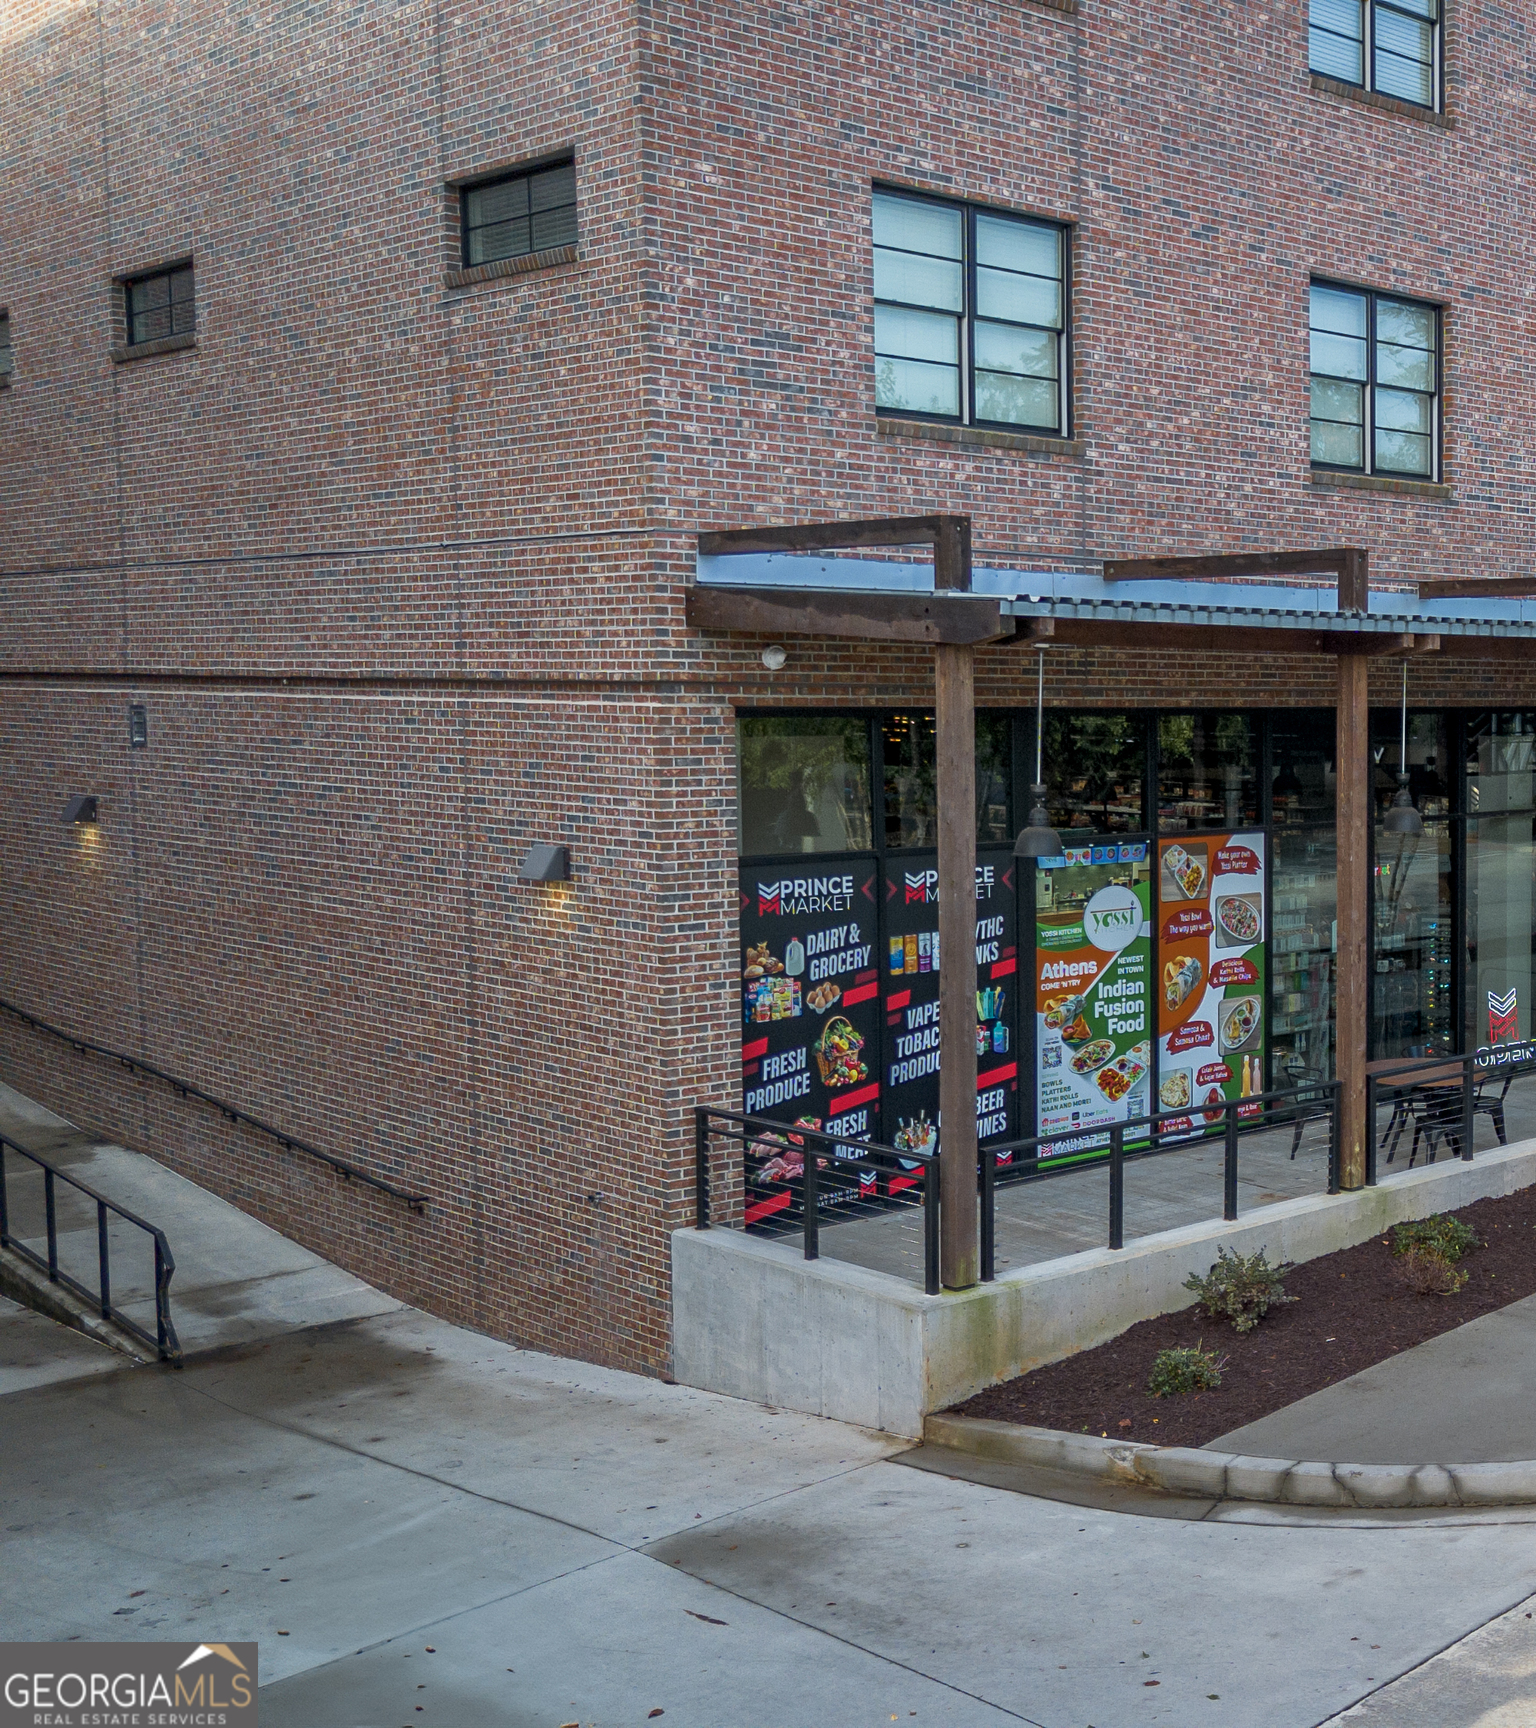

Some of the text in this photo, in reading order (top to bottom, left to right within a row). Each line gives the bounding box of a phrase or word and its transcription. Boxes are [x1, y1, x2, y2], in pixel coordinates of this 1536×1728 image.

[780, 875, 854, 899] PRINCE
[926, 866, 994, 887] PCE
[926, 883, 994, 904] MET
[780, 894, 854, 916] MARKET
[807, 922, 861, 957] DAIRY &
[810, 944, 872, 982] GROCERY
[1040, 960, 1097, 981] Athens
[1117, 955, 1144, 965] NEWEST
[1125, 965, 1144, 974] TOWN
[1041, 983, 1060, 991] COME
[1068, 979, 1081, 987] TRY
[1098, 979, 1145, 999] Indian
[907, 1000, 940, 1030] VAPE
[1094, 997, 1145, 1019] Fusion
[1108, 1013, 1145, 1036] Food
[896, 1026, 941, 1059] TOBAC
[763, 1046, 807, 1082] FRESH
[890, 1050, 941, 1087] PRODUC
[745, 1072, 811, 1115] PRODUCE
[1041, 1079, 1063, 1088] BOWLS
[1041, 1086, 1071, 1097] PLATTERS
[1060, 1092, 1079, 1101] ROLLS
[1041, 1104, 1058, 1113] NAAN
[826, 1109, 867, 1137] FRESH
[1049, 1125, 1069, 1134] clover
[1053, 1139, 1094, 1155] MARKET
